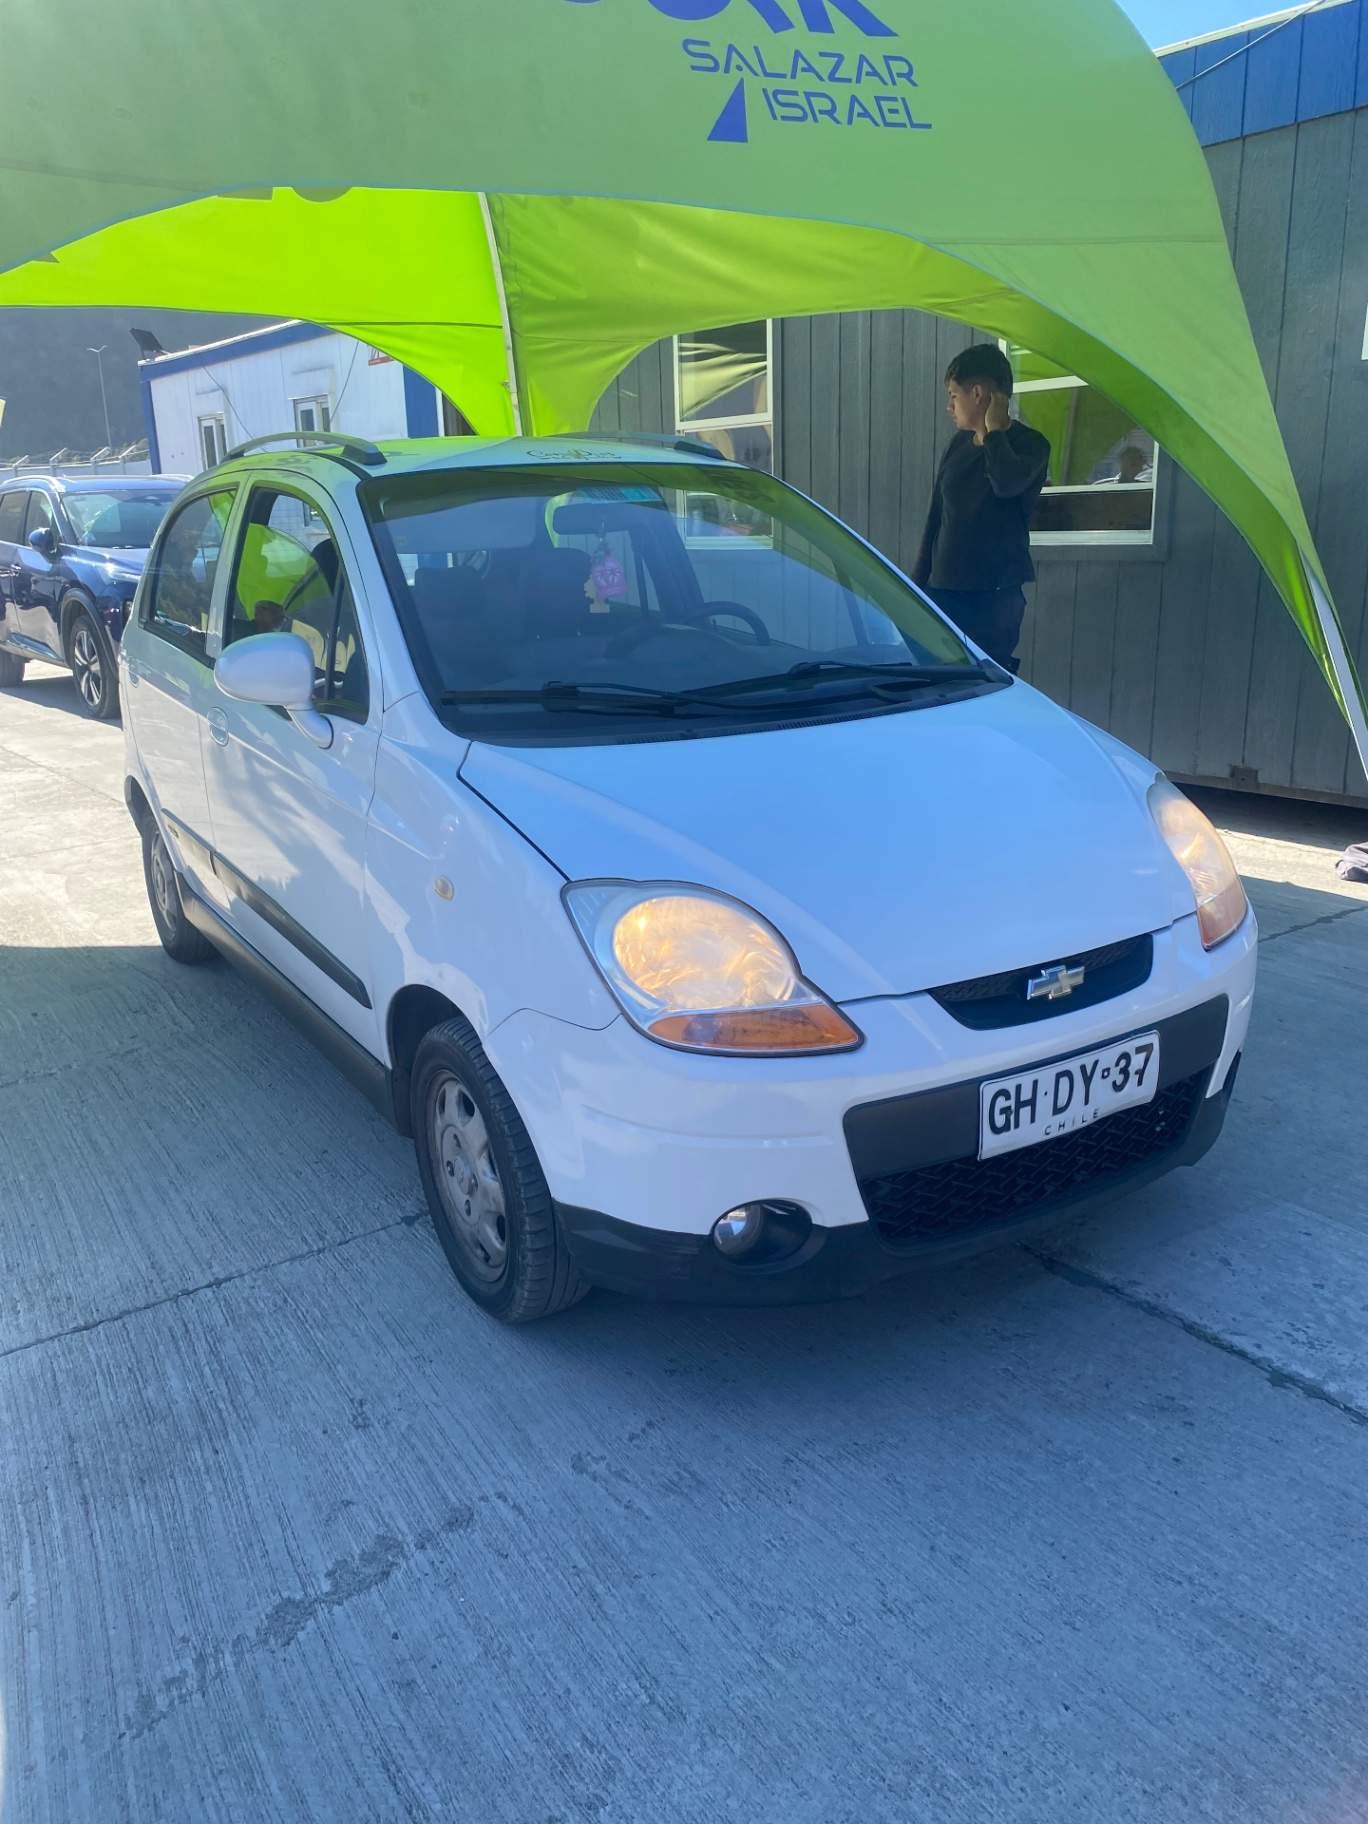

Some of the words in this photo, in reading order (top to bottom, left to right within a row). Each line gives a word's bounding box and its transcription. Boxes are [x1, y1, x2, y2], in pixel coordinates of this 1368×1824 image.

[682, 38, 918, 87] SALAZAR
[762, 87, 932, 129] ISRAEL
[1044, 1108, 1099, 1136] CHILE
